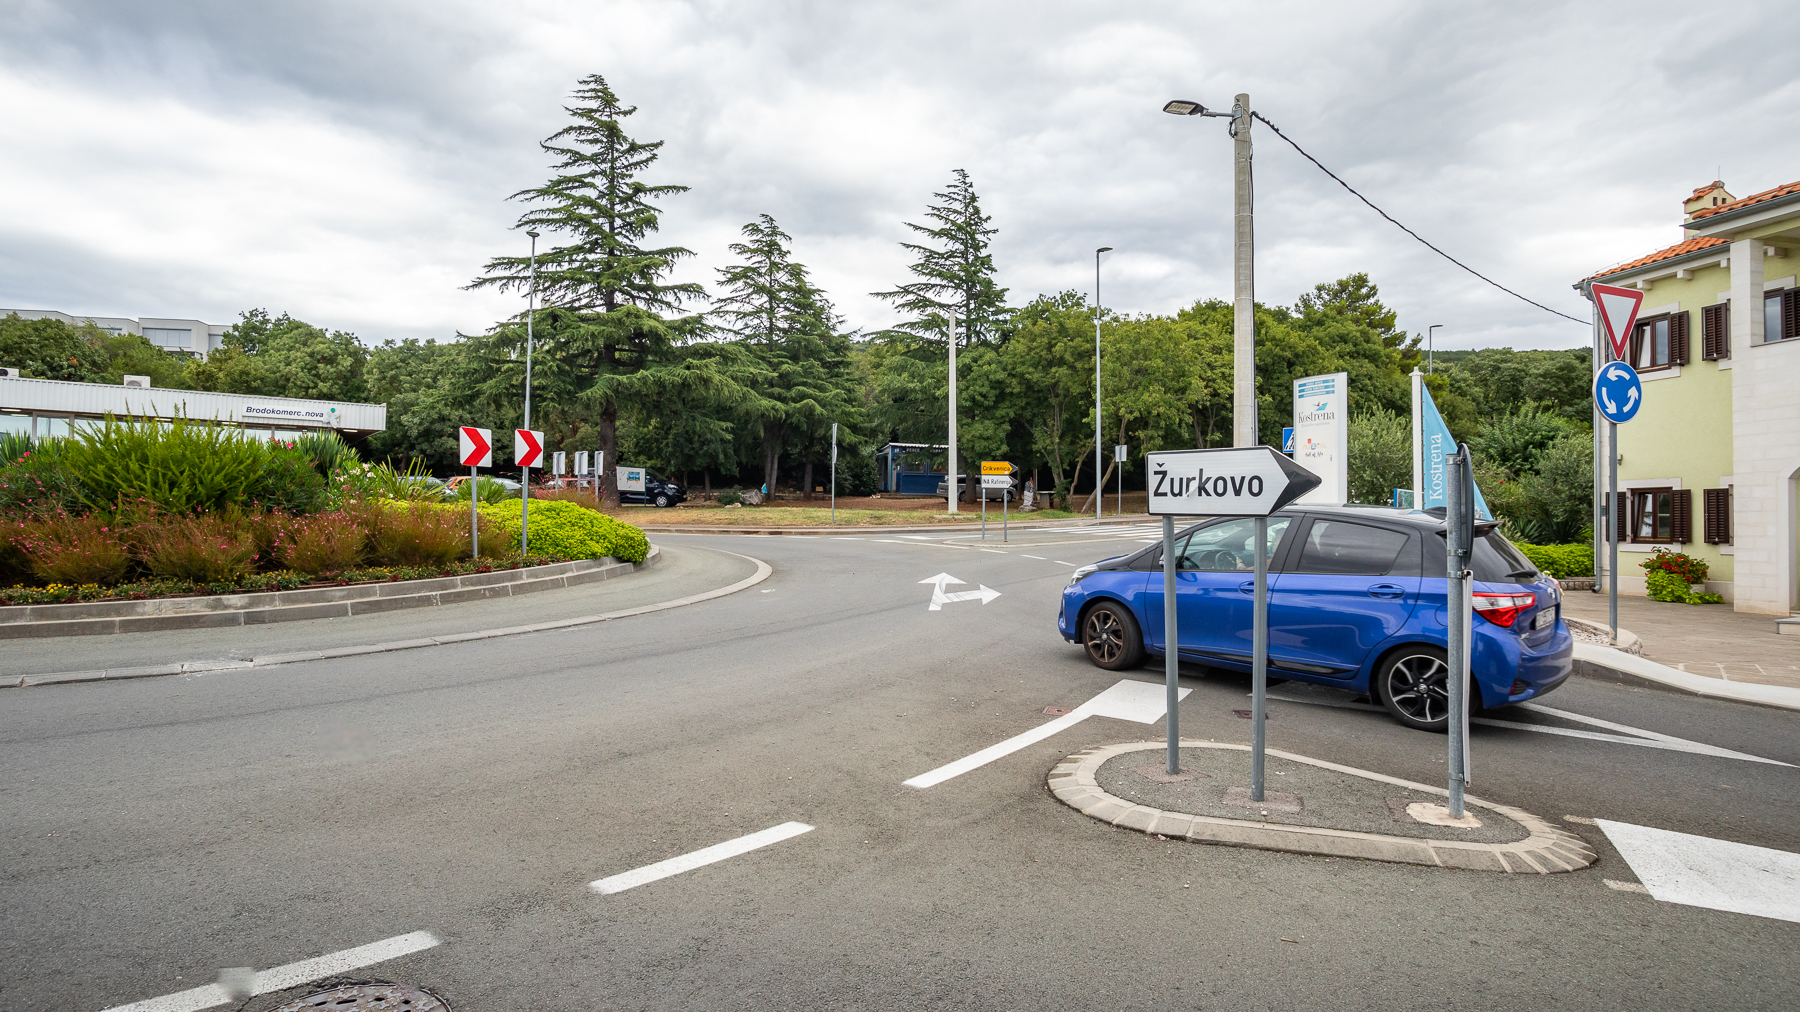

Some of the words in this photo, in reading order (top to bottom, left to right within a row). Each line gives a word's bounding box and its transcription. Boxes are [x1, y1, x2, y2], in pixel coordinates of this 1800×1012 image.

[1298, 411, 1335, 423] Kostrena
[1153, 463, 1264, 497] Žurkovo
[1429, 433, 1443, 500] Kostrena
